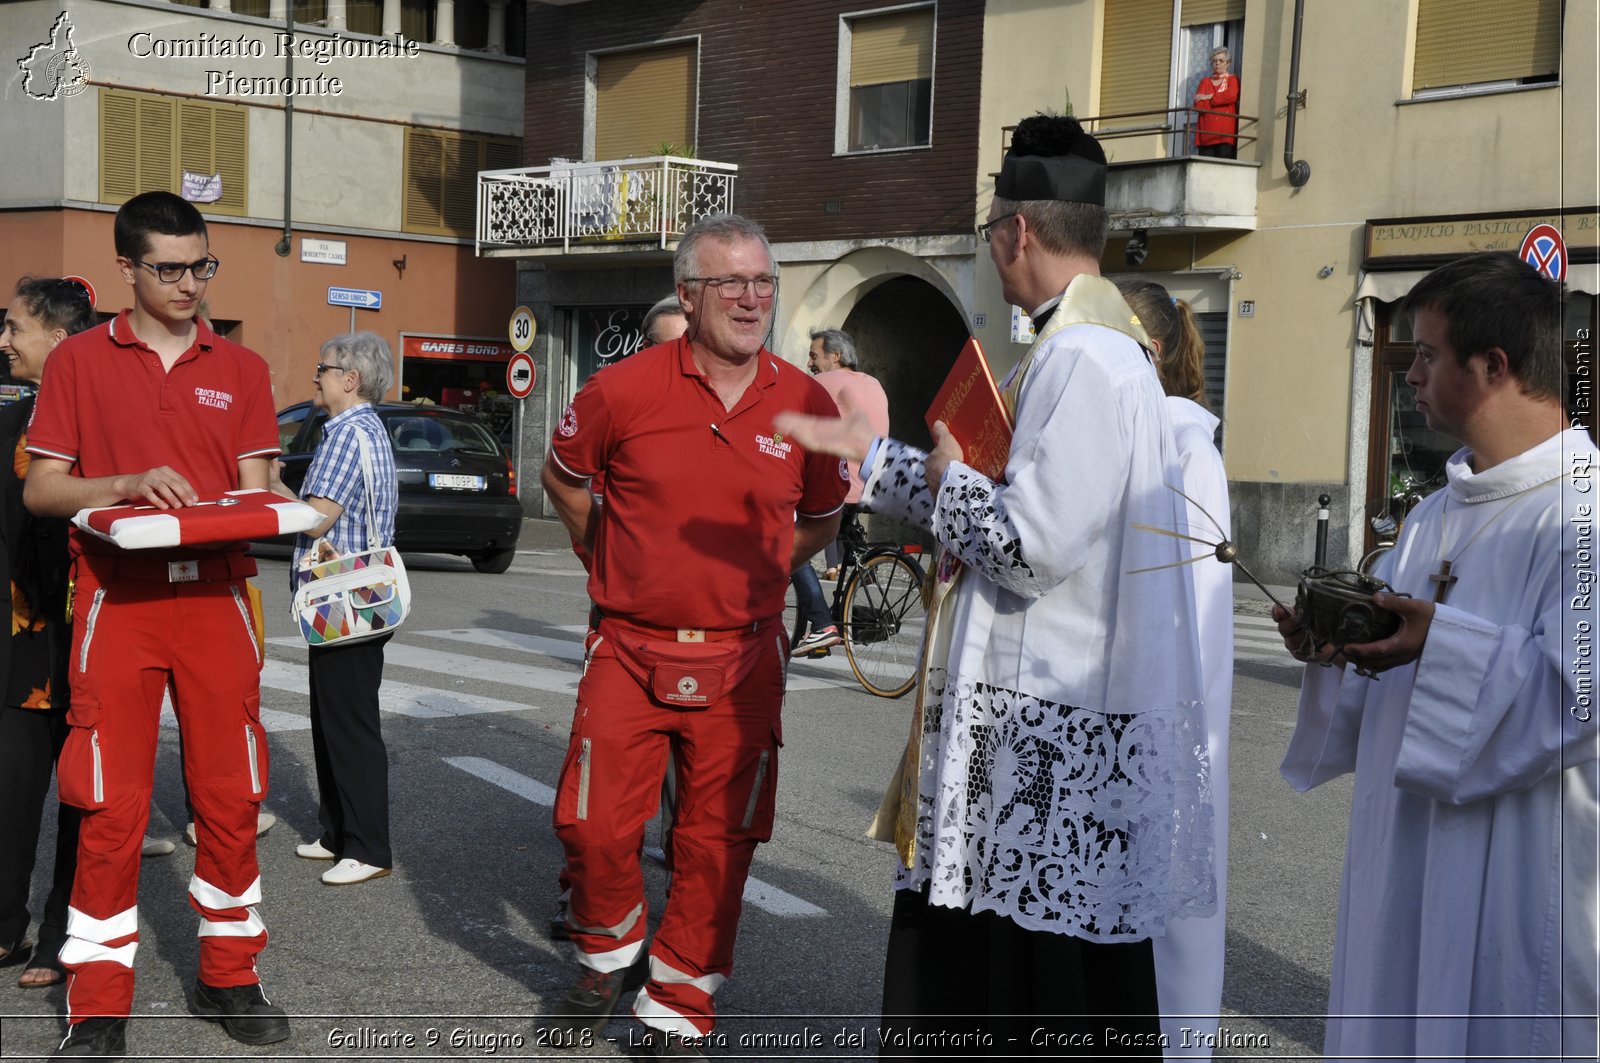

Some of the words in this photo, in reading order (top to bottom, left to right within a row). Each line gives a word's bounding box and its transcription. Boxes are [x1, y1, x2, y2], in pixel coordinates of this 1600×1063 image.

[184, 172, 220, 184] AFFITSI
[1375, 225, 1454, 241] PANIFICIO
[331, 292, 349, 301] SENSO
[350, 294, 367, 302] UNICO
[1242, 304, 1251, 313] 23
[976, 316, 984, 325] 22
[515, 318, 530, 339] 30
[421, 342, 464, 354] GAMES
[466, 344, 499, 356] BOND
[194, 387, 215, 398] CROCE
[215, 390, 233, 403] ROSSA
[198, 396, 228, 410] ITALIANA
[755, 434, 774, 446] CROCE
[759, 443, 786, 460] ITALIANA
[436, 475, 447, 486] CL
[451, 476, 477, 488] 109PL
